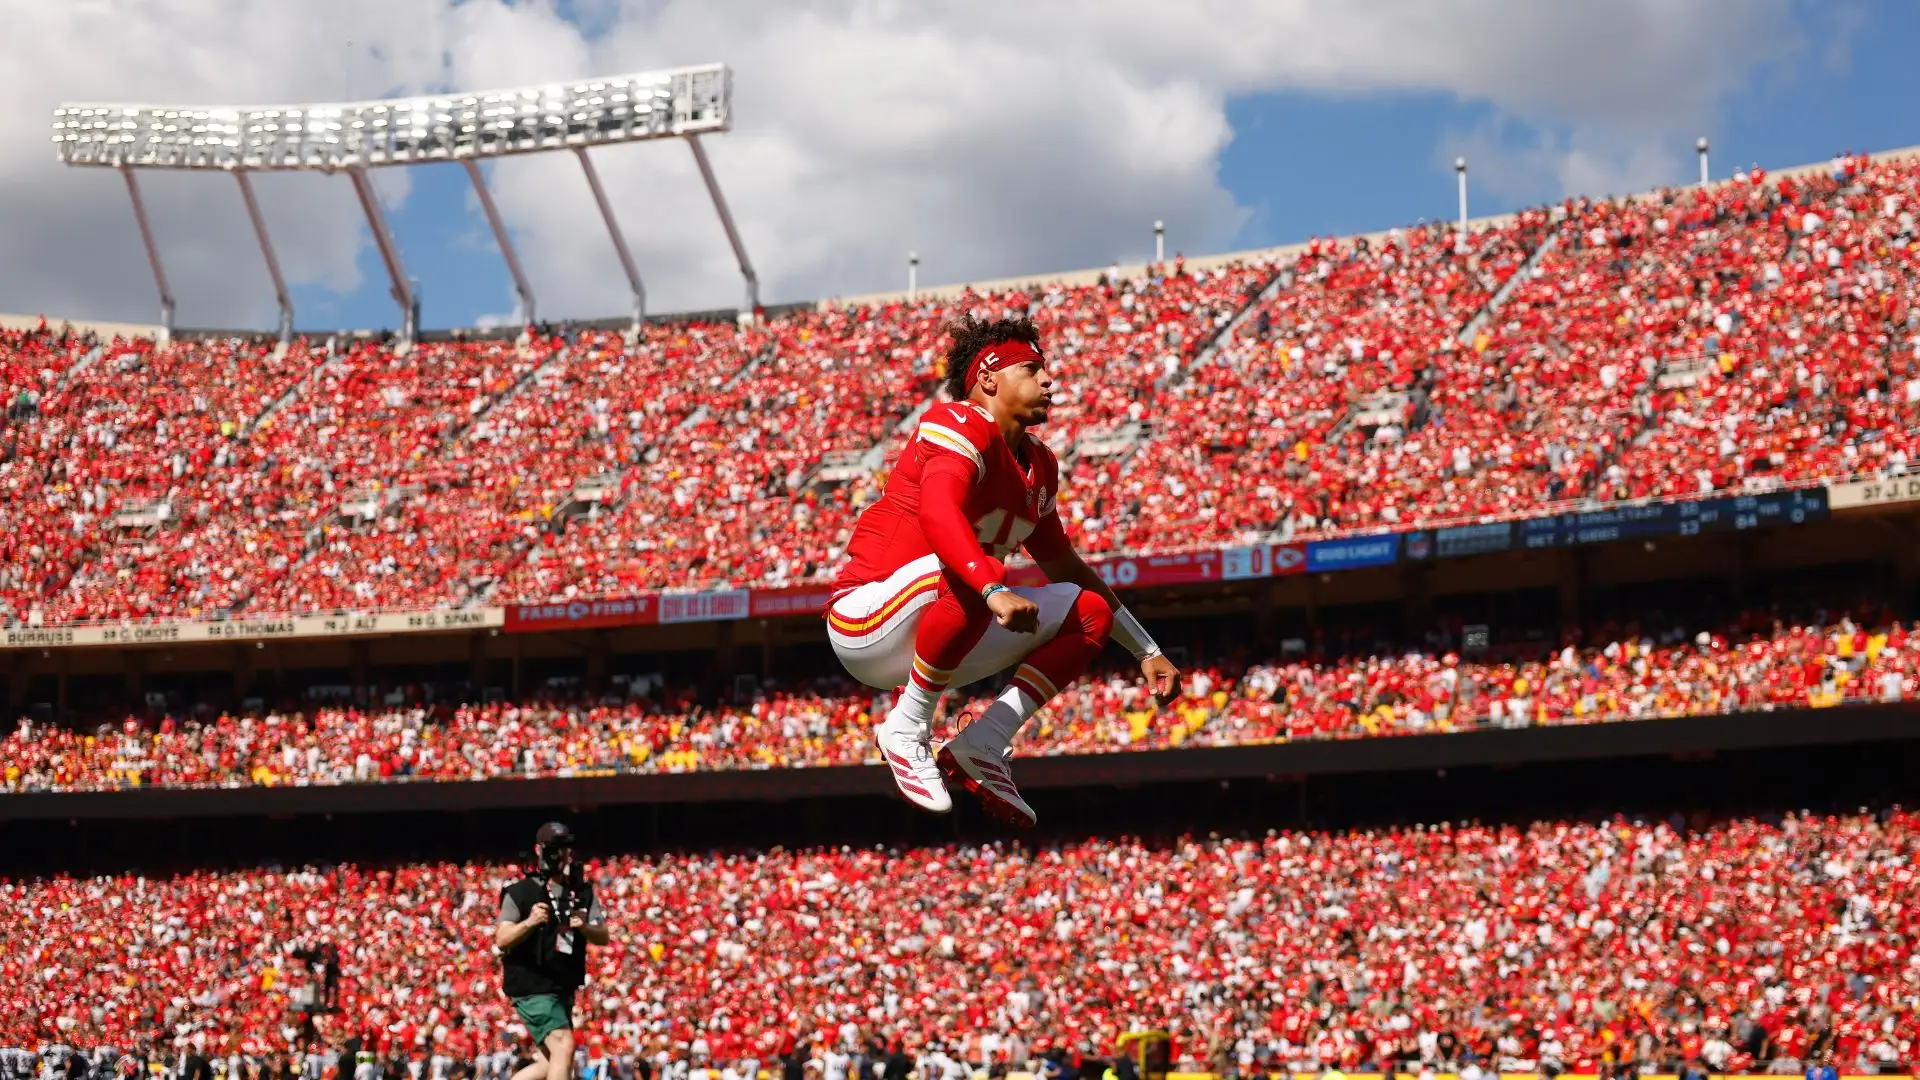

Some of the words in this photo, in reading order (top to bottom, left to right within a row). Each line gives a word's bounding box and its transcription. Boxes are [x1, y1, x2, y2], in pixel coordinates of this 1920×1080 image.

[1316, 545, 1348, 562] BUD
[1351, 541, 1391, 559] LIGHT
[519, 606, 565, 621] FANS
[593, 600, 649, 616] FIRST
[8, 630, 73, 643] BURRUSS
[239, 621, 295, 634] THOMAS
